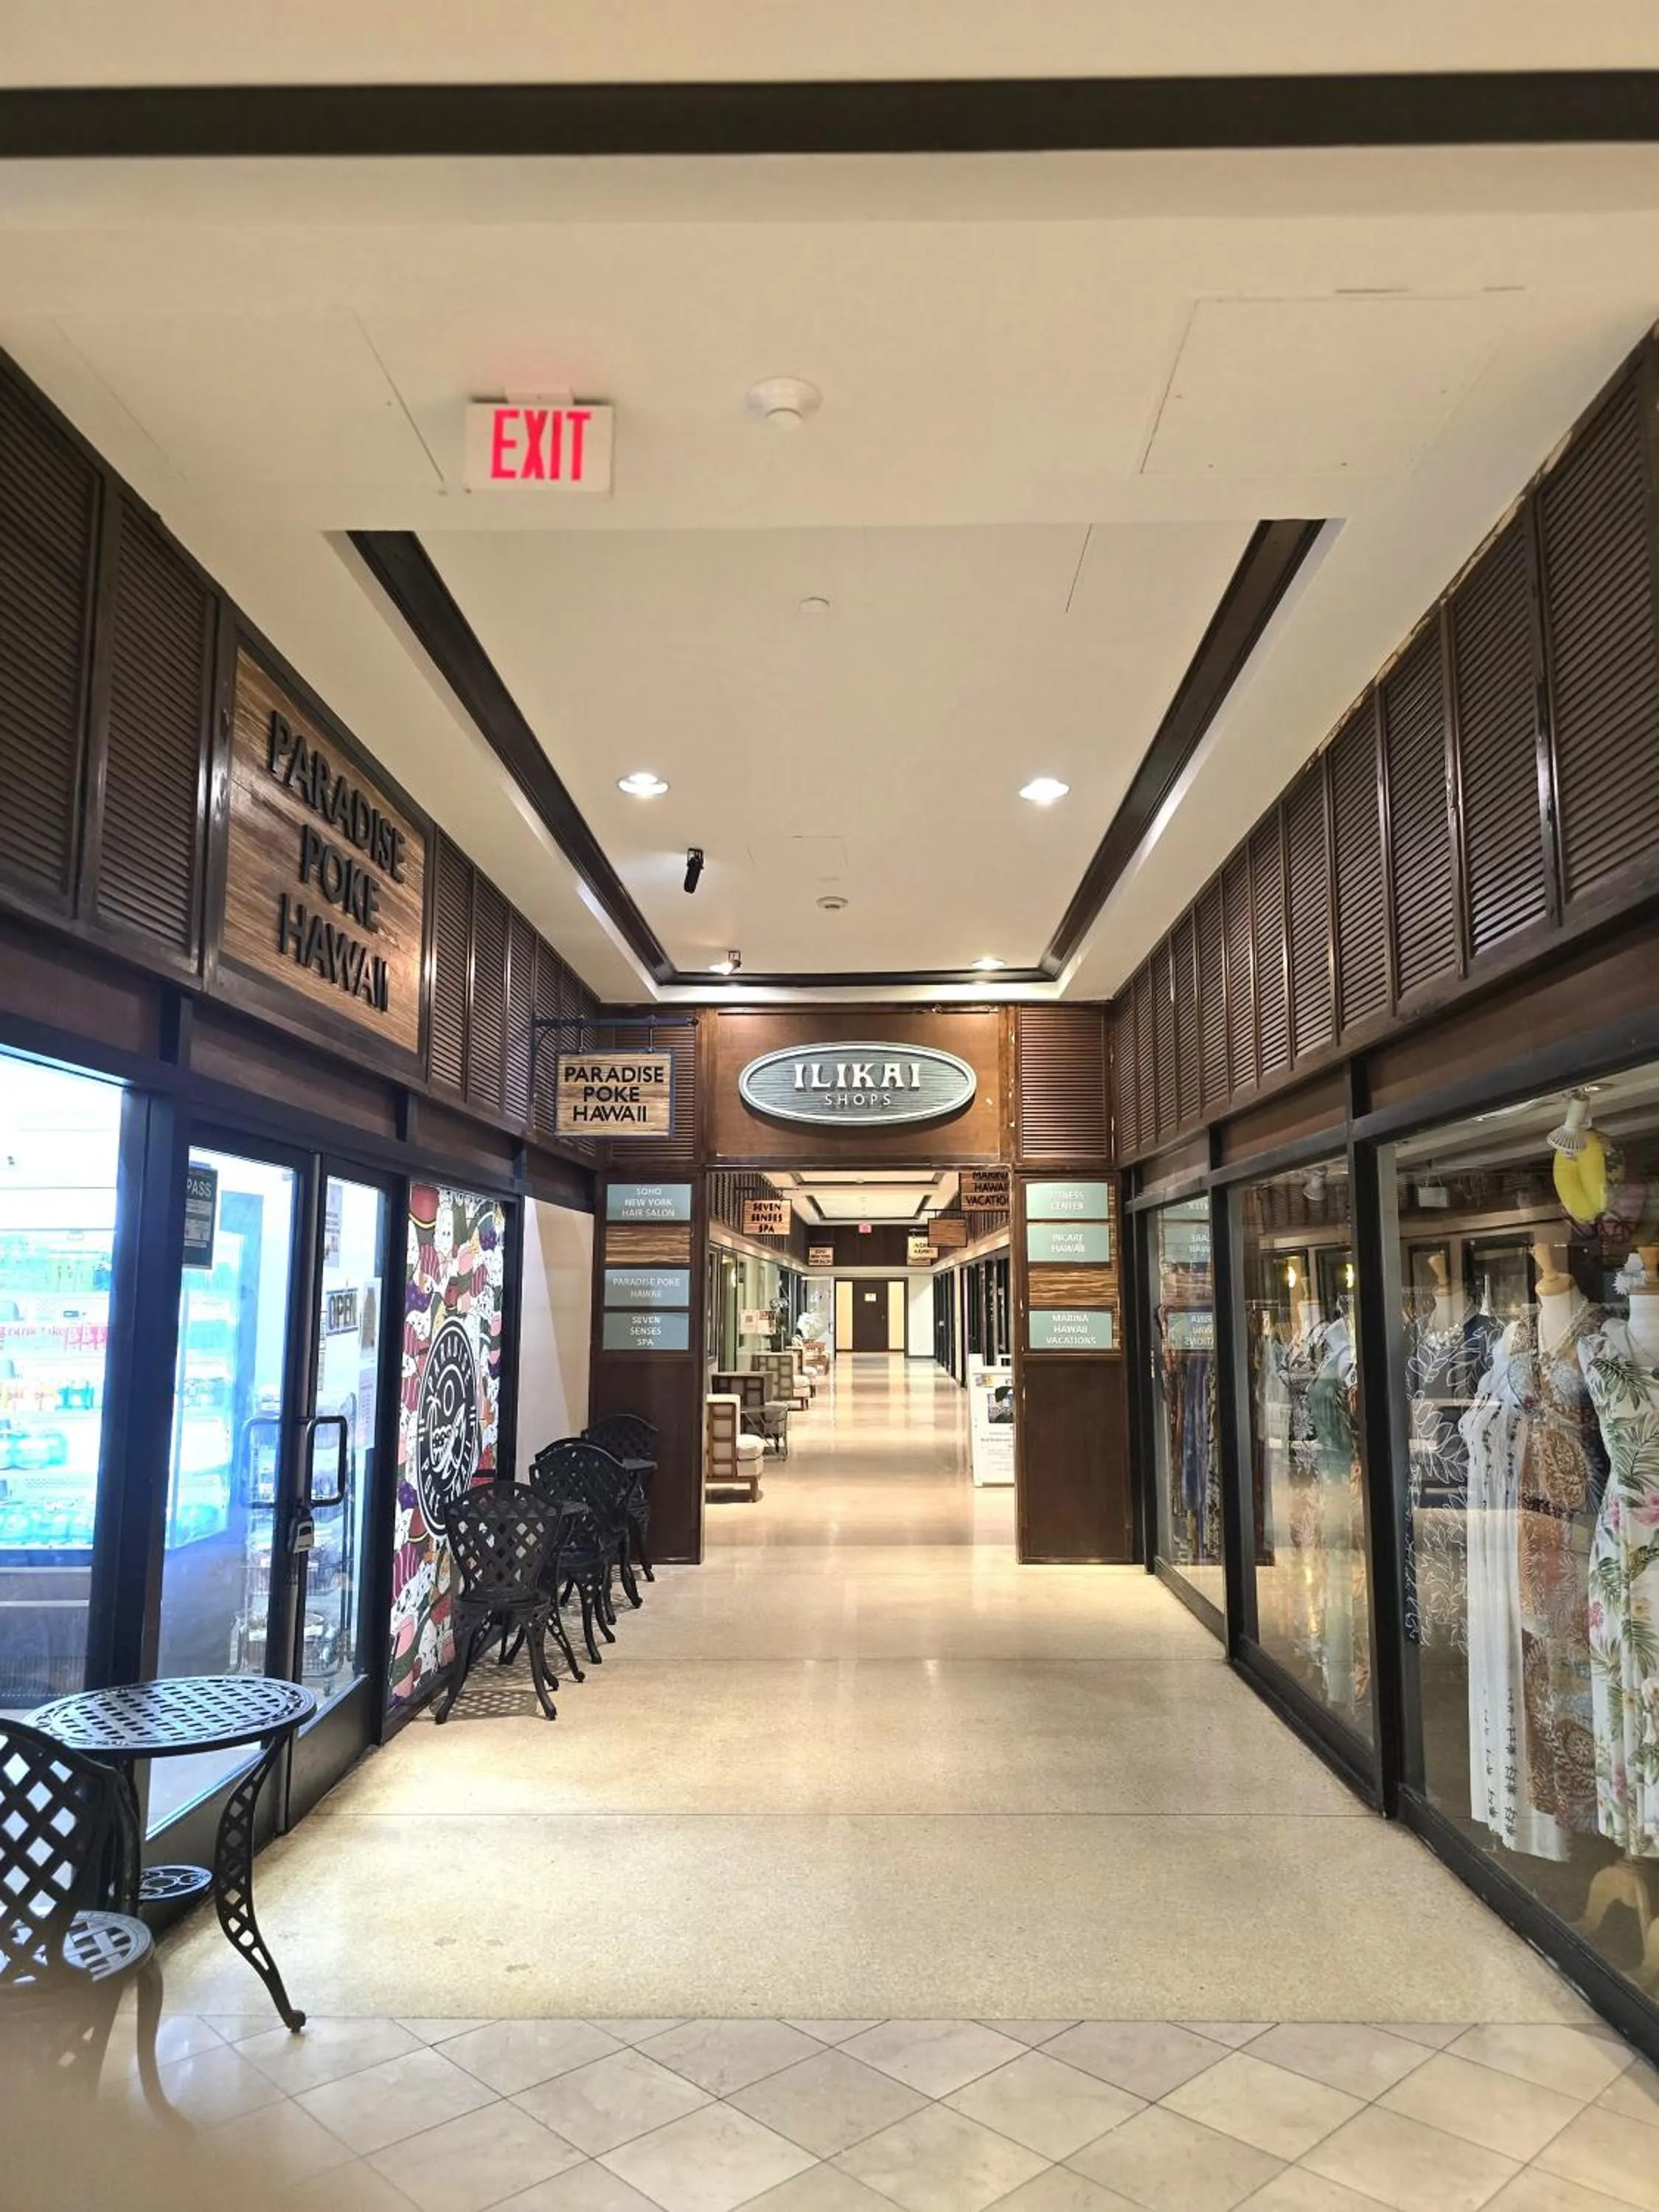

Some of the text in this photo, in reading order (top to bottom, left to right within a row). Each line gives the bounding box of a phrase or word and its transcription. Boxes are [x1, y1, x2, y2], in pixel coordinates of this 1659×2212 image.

[491, 409, 592, 481] EXIT
[268, 710, 406, 884] PARADISE
[300, 823, 380, 934] POKE
[279, 892, 389, 1012] HAWAII
[564, 1066, 664, 1083] PARADISE
[793, 1062, 922, 1089] ILIKAI
[583, 1086, 640, 1103] POKE
[824, 1093, 891, 1106] SHOPS
[573, 1105, 647, 1122] HAWAII
[187, 1178, 212, 1198] PASS
[636, 1187, 661, 1195] SOHO
[625, 1198, 672, 1206] NEW YORK
[965, 1194, 1009, 1206] VACATIO
[753, 1203, 781, 1211] SEVEN
[1051, 1202, 1084, 1211] CENTER
[622, 1208, 675, 1217] HAIR SALON
[751, 1213, 782, 1222] SENSES
[758, 1224, 775, 1233] SPA
[1051, 1244, 1085, 1253] HAWAII
[613, 1277, 681, 1287] PARADISE POKE
[632, 1316, 661, 1324] SEVEN
[1052, 1313, 1089, 1322] MARINA
[630, 1326, 661, 1335] SENSES
[1054, 1325, 1088, 1333] HAWAII
[636, 1338, 654, 1346] SPA
[1046, 1336, 1097, 1345] VACATIONS
[427, 1335, 472, 1394] PARADISE
